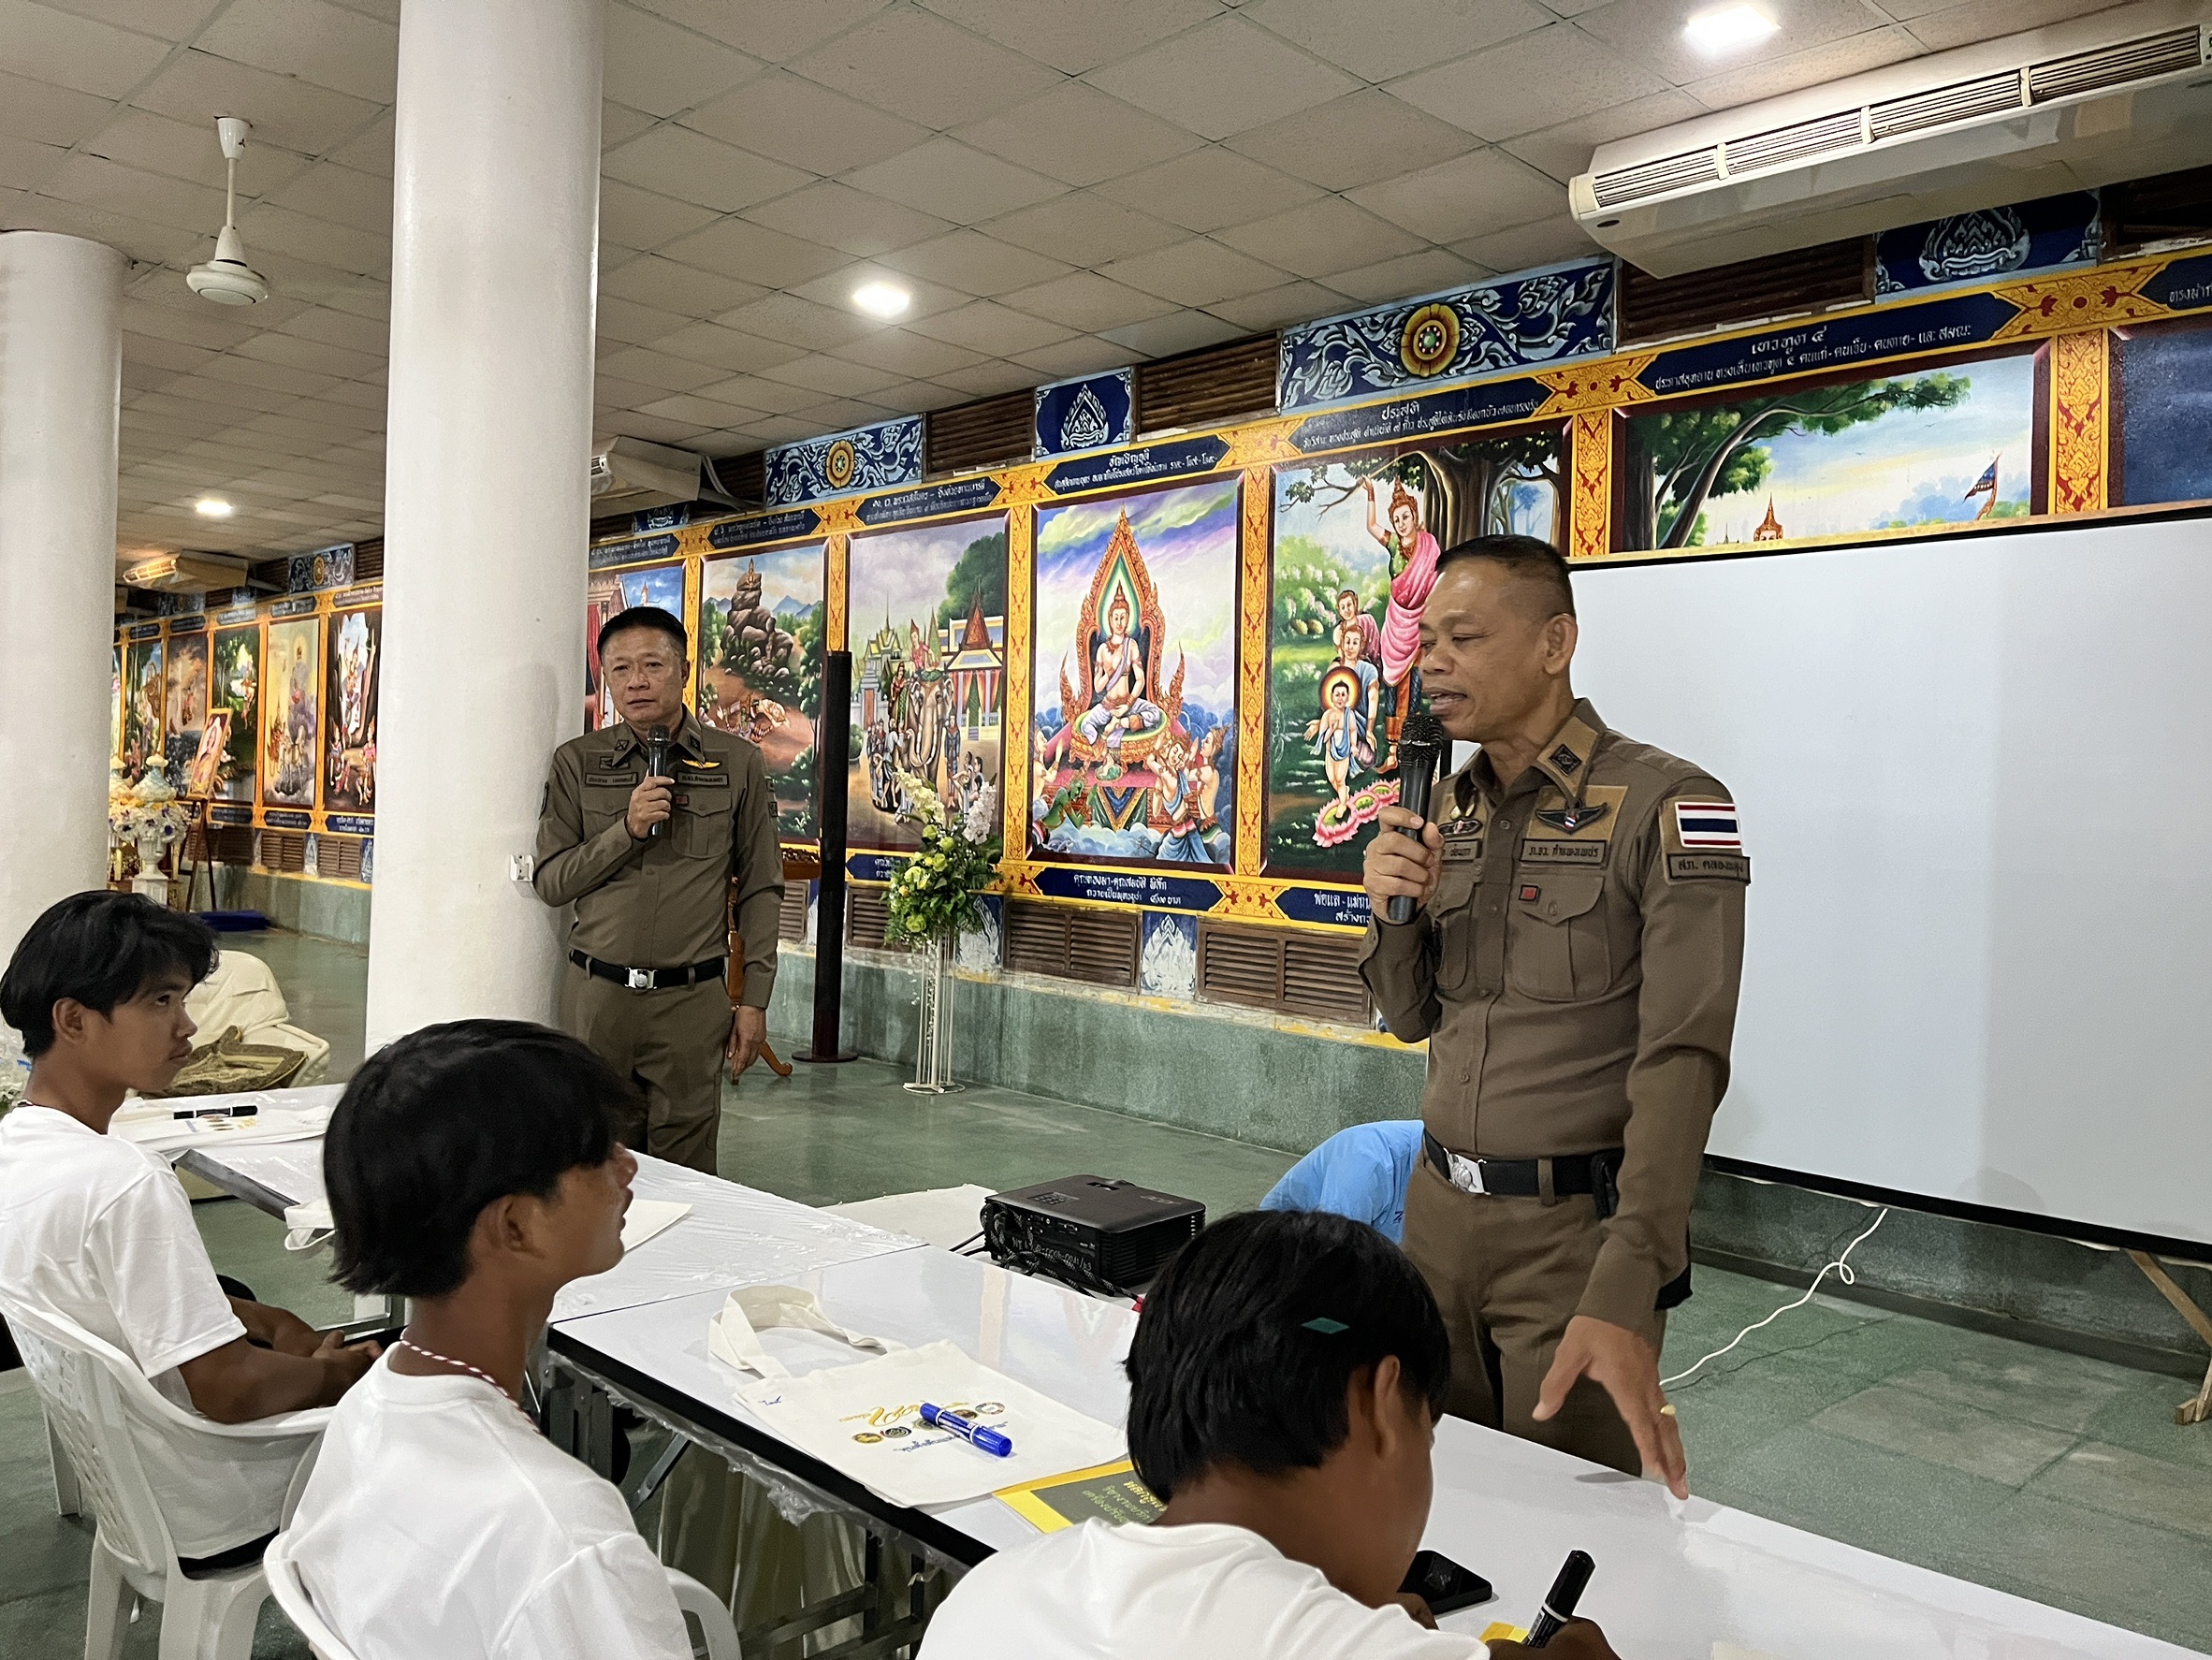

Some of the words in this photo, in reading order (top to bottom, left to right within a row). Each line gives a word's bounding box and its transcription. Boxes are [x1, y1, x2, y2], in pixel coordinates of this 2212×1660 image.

[1752, 332, 1807, 355] เทวทูต
[1918, 329, 1936, 344] และ
[1939, 325, 1972, 342] สมณะ
